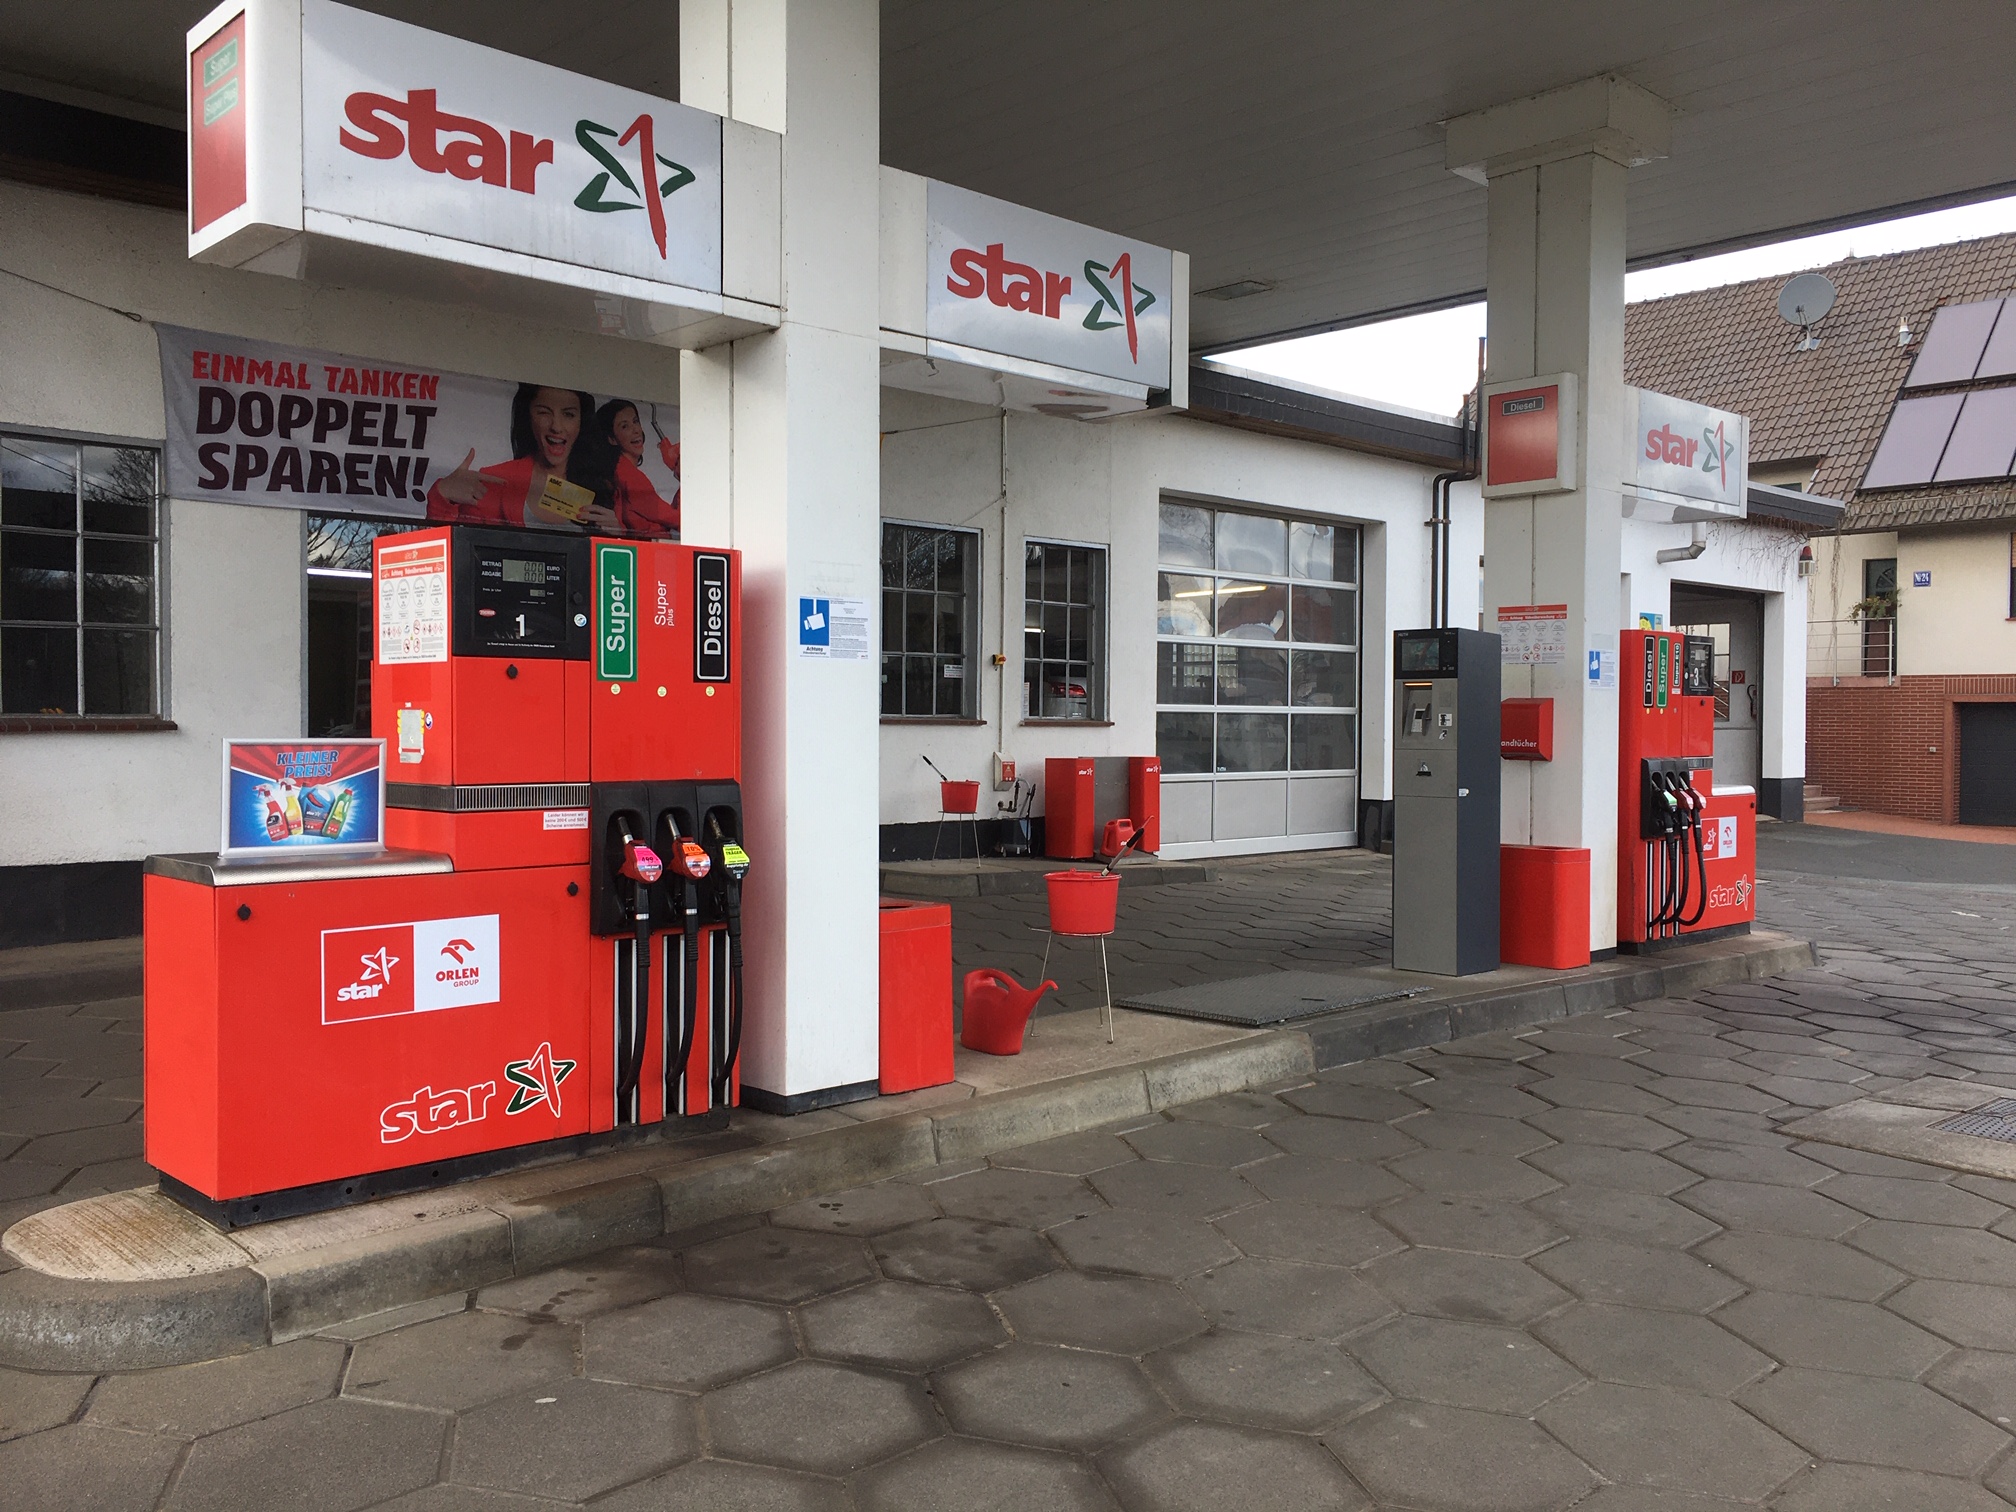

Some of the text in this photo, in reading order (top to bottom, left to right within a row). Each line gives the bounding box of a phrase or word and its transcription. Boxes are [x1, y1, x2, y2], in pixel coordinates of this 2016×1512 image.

[339, 88, 553, 195] star
[946, 243, 1072, 320] star
[192, 351, 440, 401] EINMAL TANKEN
[195, 386, 438, 450] DOPPELT
[1510, 400, 1537, 413] Diesel
[1645, 423, 1698, 468] star
[197, 441, 431, 502] SPAREN!
[606, 574, 630, 652] Super
[654, 580, 670, 626] Super
[667, 608, 675, 627] plus
[703, 580, 721, 655] Diesel
[515, 614, 525, 637] 1
[1645, 650, 1653, 692] Diesel
[1659, 652, 1667, 693] Super
[1693, 667, 1699, 687] 3
[276, 750, 339, 766] KLEINER
[1501, 739, 1537, 748] andtücher
[284, 764, 332, 778] PREIS!
[1709, 885, 1735, 908] star
[337, 981, 383, 1002] star
[435, 967, 479, 982] ORLEN
[453, 978, 479, 988] GROUP
[380, 1080, 496, 1144] star
